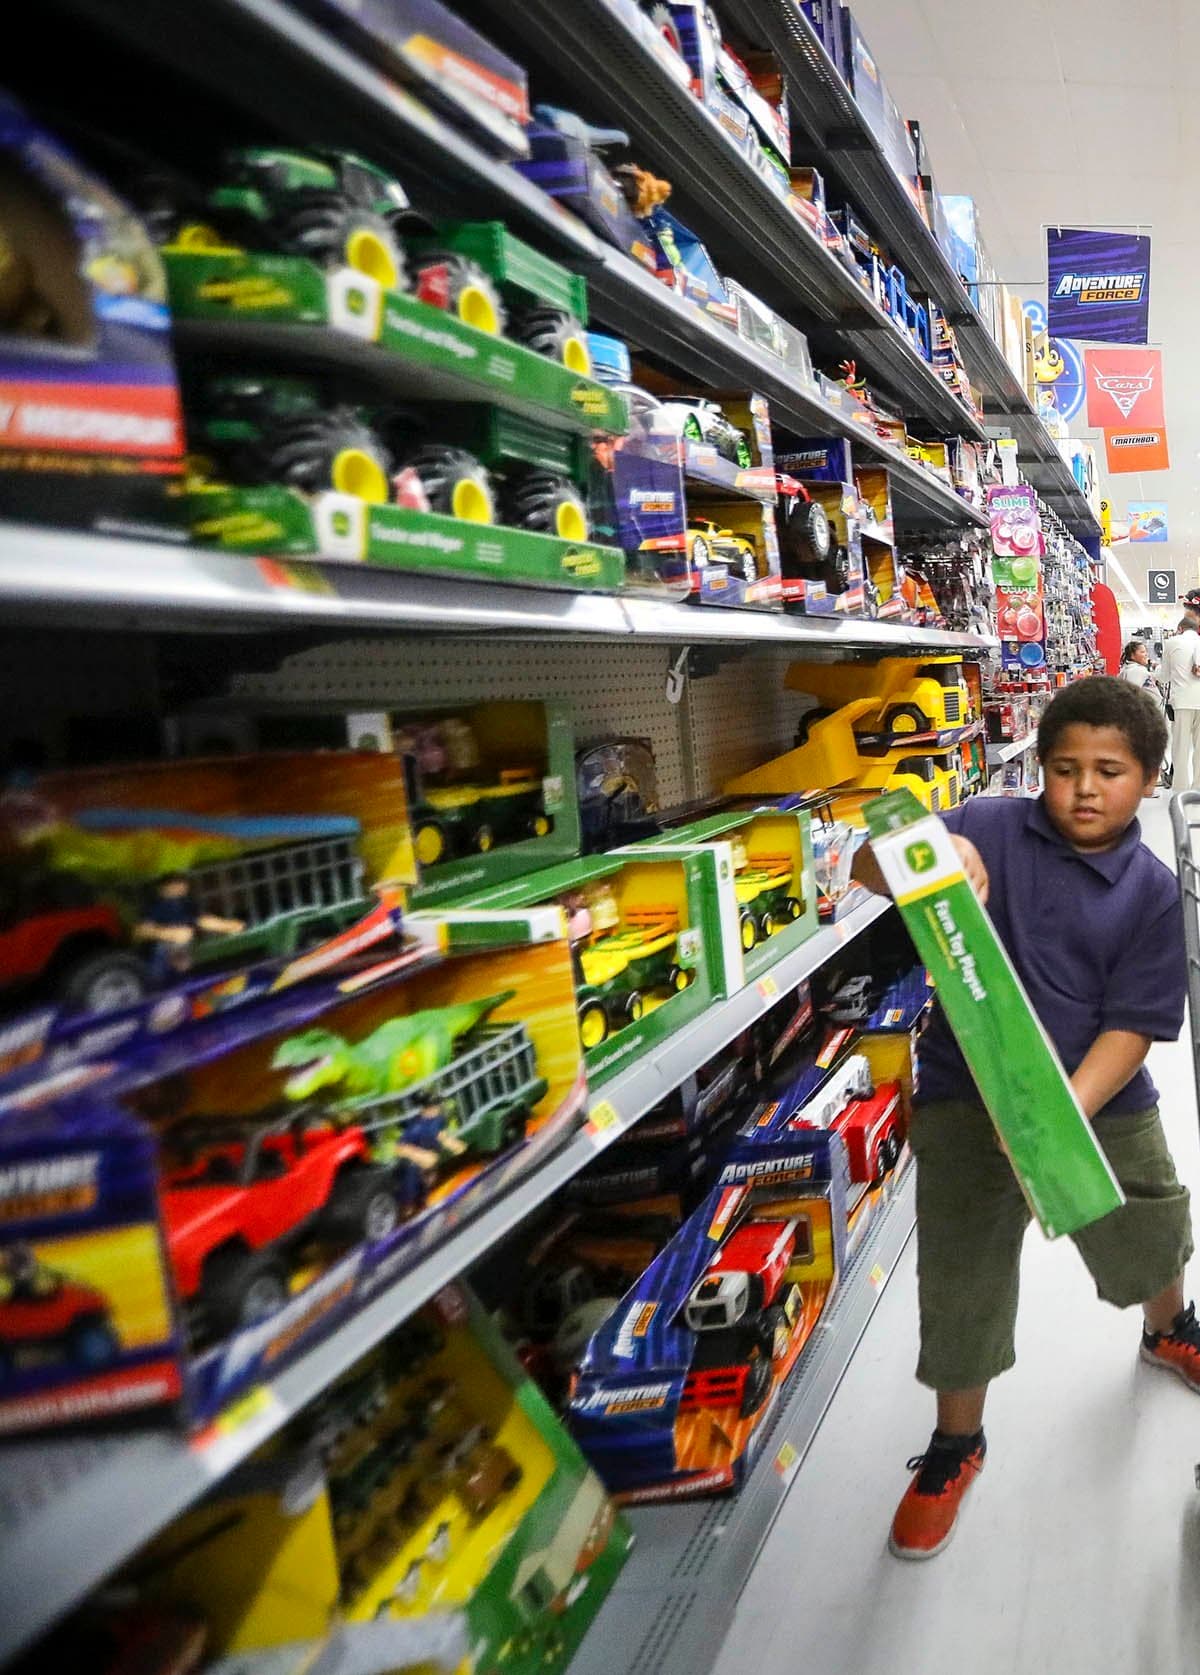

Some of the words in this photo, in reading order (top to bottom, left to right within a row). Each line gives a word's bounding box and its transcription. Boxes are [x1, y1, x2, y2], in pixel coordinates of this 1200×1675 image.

[1056, 275, 1143, 294] ADVENTURE
[1087, 290, 1134, 300] FORCE
[1102, 378, 1144, 389] Cars
[1115, 436, 1155, 445] MATCHBOX
[992, 497, 1030, 509] SLIME
[935, 899, 957, 935] Farm
[950, 931, 966, 957] Toy
[958, 953, 988, 1002] Playset
[719, 1153, 814, 1185] ADVENTURE
[752, 1169, 806, 1185] FORCE
[584, 1382, 672, 1410] ADVENTURE
[610, 1398, 663, 1413] FORCE
